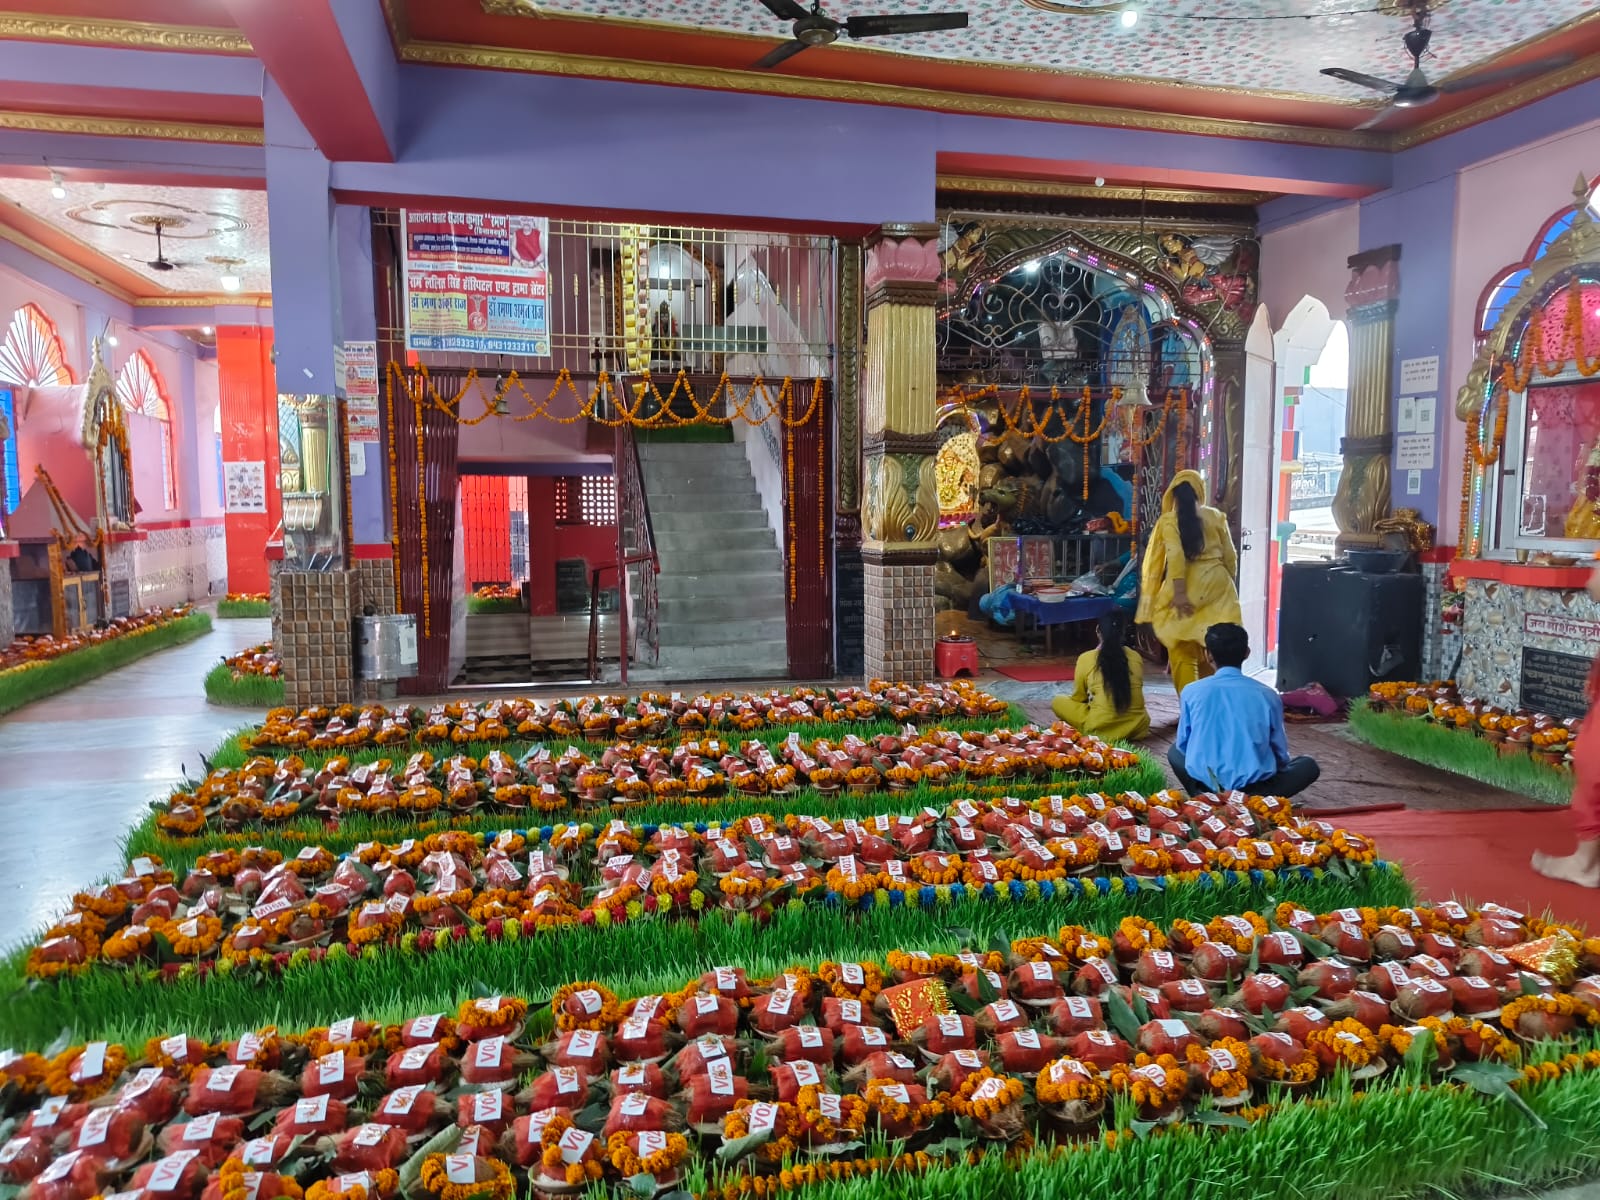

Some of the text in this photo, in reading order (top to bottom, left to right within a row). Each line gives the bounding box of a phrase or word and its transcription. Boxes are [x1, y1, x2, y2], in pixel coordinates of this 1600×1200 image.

[409, 276, 422, 289] राम
[425, 274, 446, 289] ललित
[448, 273, 461, 289] सिंह
[463, 276, 493, 293] हॉस्पिटल
[497, 301, 513, 318] रमण
[530, 304, 545, 320] राज
[1529, 619, 1546, 628] जय
